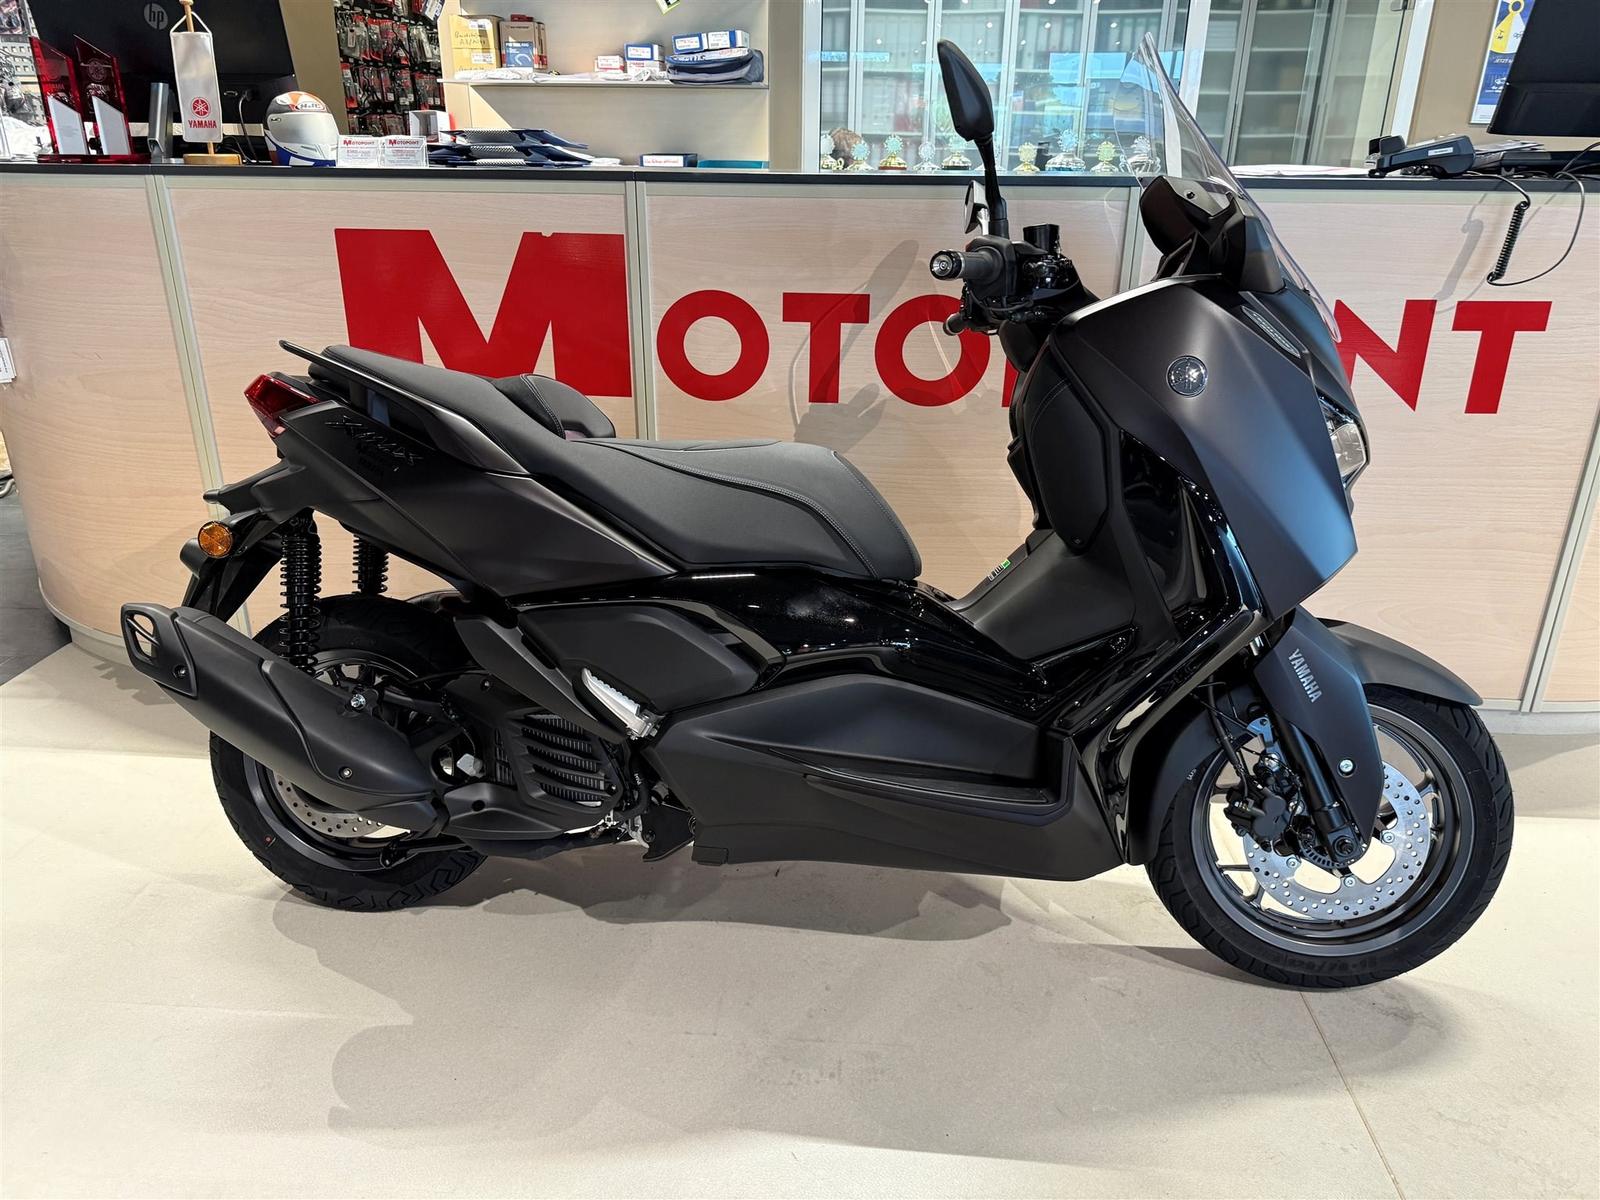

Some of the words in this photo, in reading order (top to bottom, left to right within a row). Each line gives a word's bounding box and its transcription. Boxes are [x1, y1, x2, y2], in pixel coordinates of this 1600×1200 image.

[148, 3, 164, 29] hp
[188, 120, 217, 129] YAMAHA
[334, 228, 1552, 414] MOTONT
[1288, 648, 1322, 703] YAMAHA
